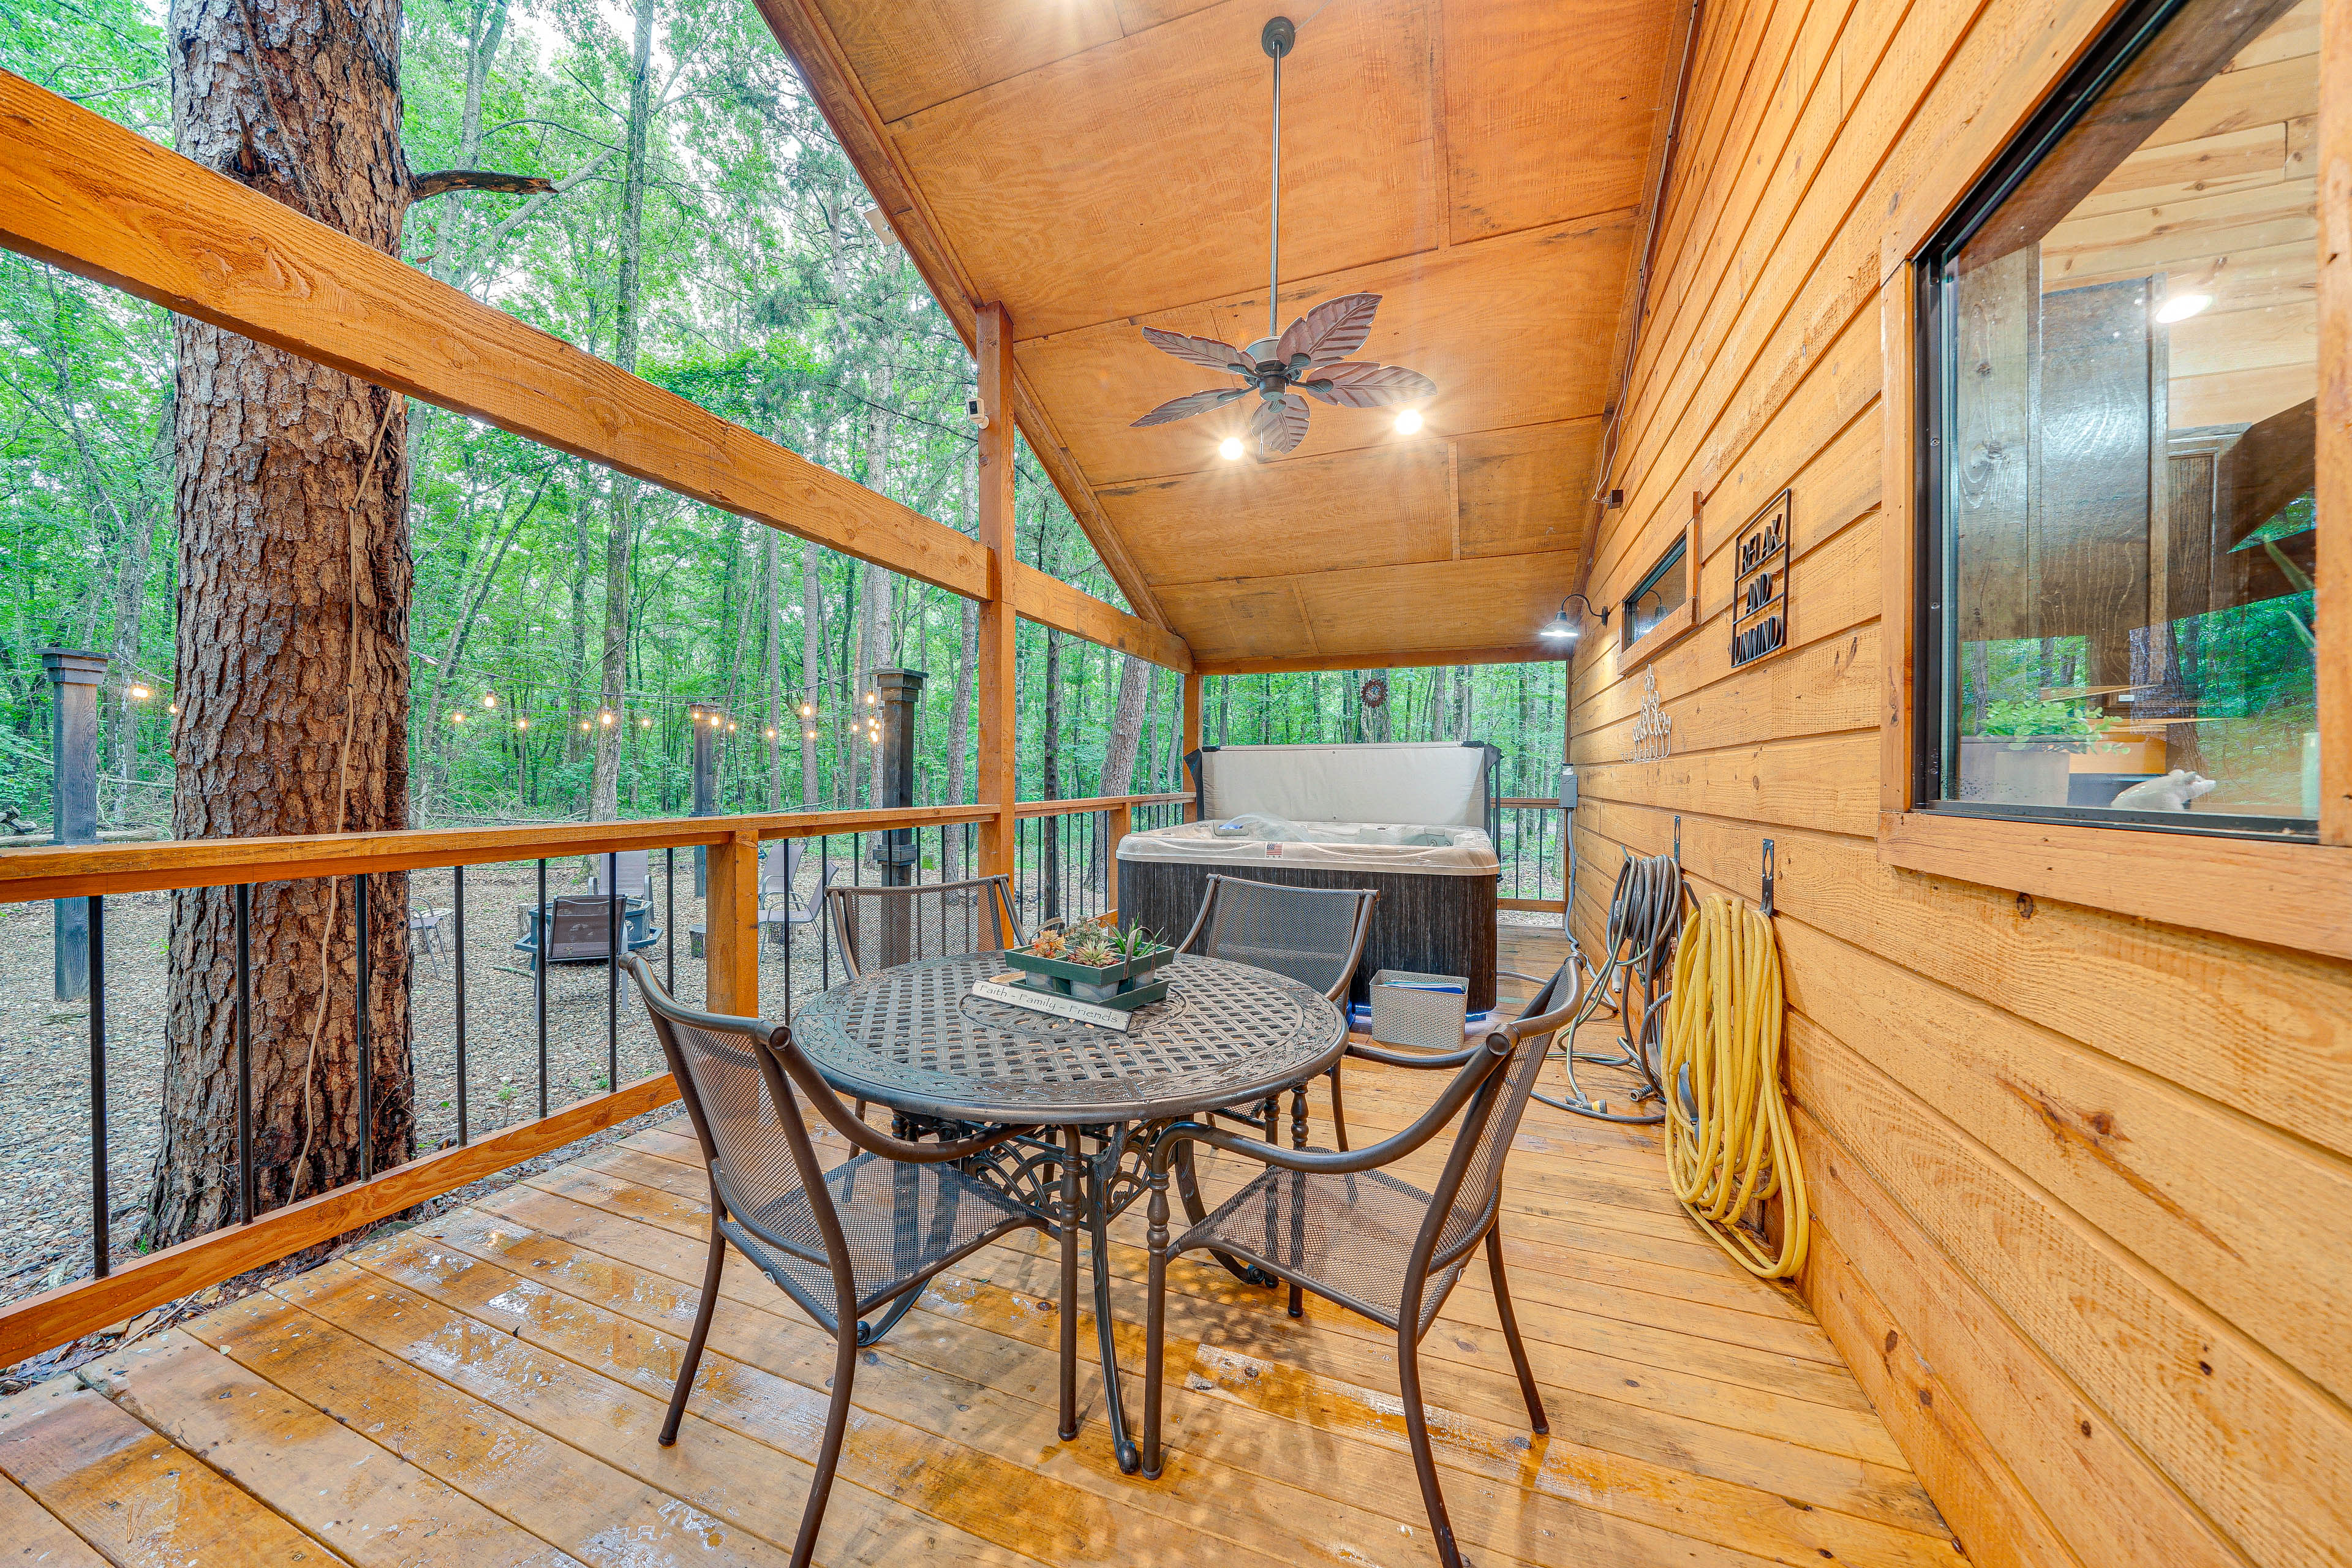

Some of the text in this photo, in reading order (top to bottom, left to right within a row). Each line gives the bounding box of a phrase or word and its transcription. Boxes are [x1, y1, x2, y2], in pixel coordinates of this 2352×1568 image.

[1742, 513, 1783, 573] RELAX
[1746, 572, 1773, 616] AND
[1734, 616, 1783, 664] UNWIND
[979, 984, 1008, 997] Faith
[1019, 993, 1056, 1012] Family
[1069, 1005, 1118, 1023] Friends
